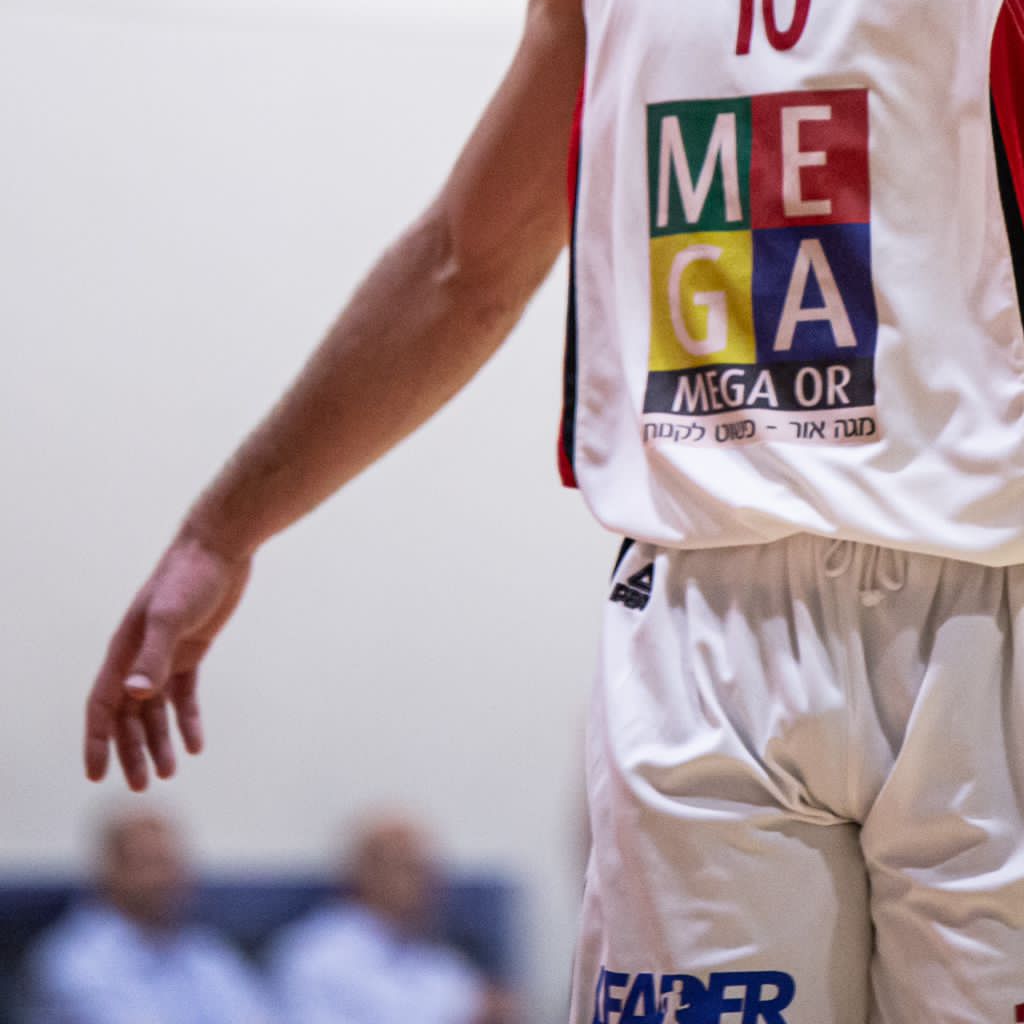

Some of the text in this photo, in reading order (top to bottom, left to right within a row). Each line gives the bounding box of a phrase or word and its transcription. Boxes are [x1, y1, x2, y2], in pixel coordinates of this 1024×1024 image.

[671, 365, 851, 413] MEGA OR
[788, 420, 826, 439] אור
